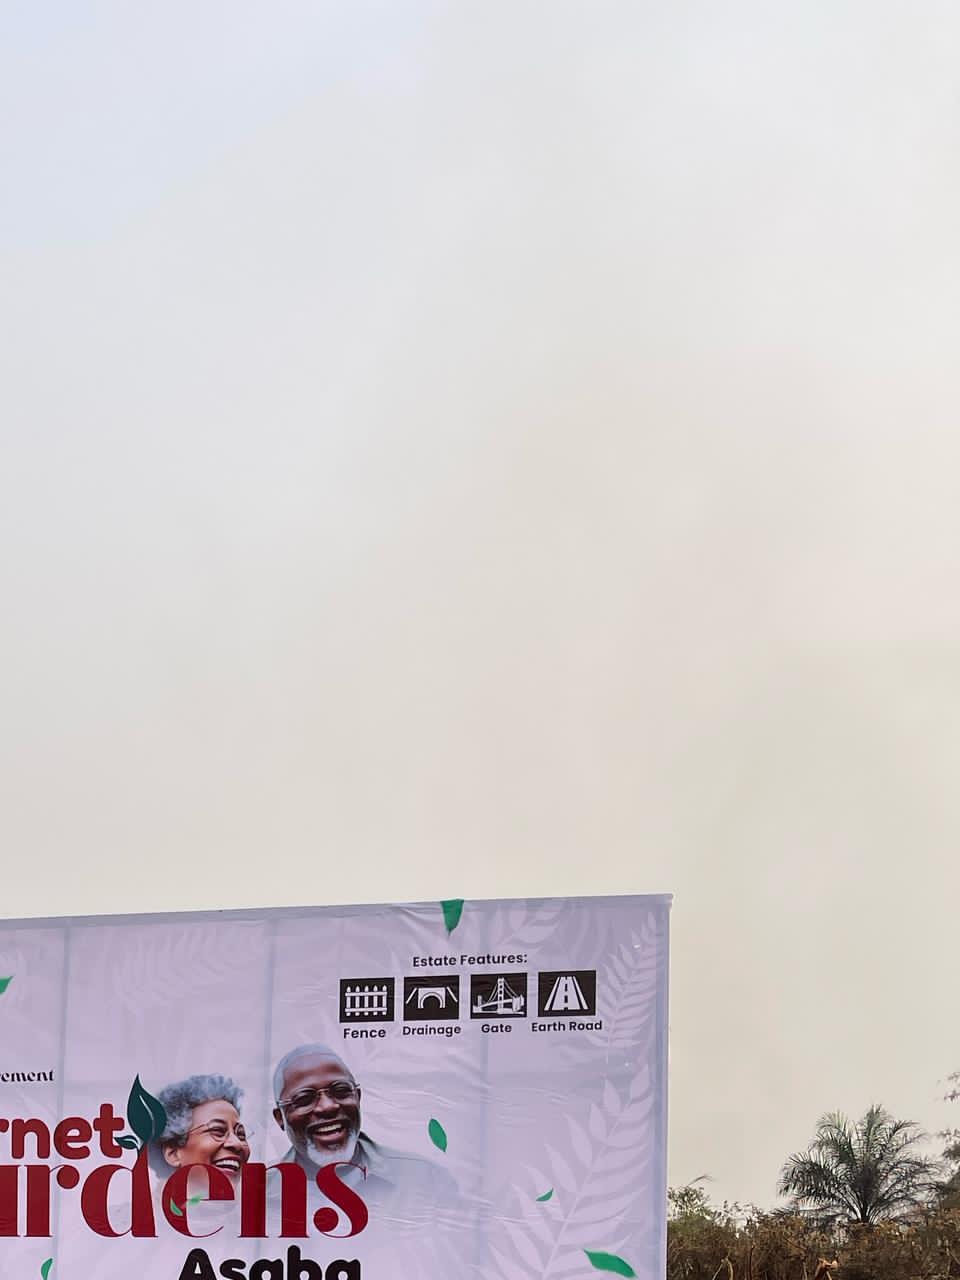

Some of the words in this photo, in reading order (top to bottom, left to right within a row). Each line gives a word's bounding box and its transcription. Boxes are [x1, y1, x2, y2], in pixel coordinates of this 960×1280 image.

[412, 956, 457, 967] Estate
[460, 953, 528, 966] Features:
[402, 1025, 462, 1038] Drainage
[481, 1023, 512, 1034] Gate
[531, 1021, 566, 1032] Earth
[569, 1020, 603, 1031] Road
[343, 1027, 386, 1039] Fence
